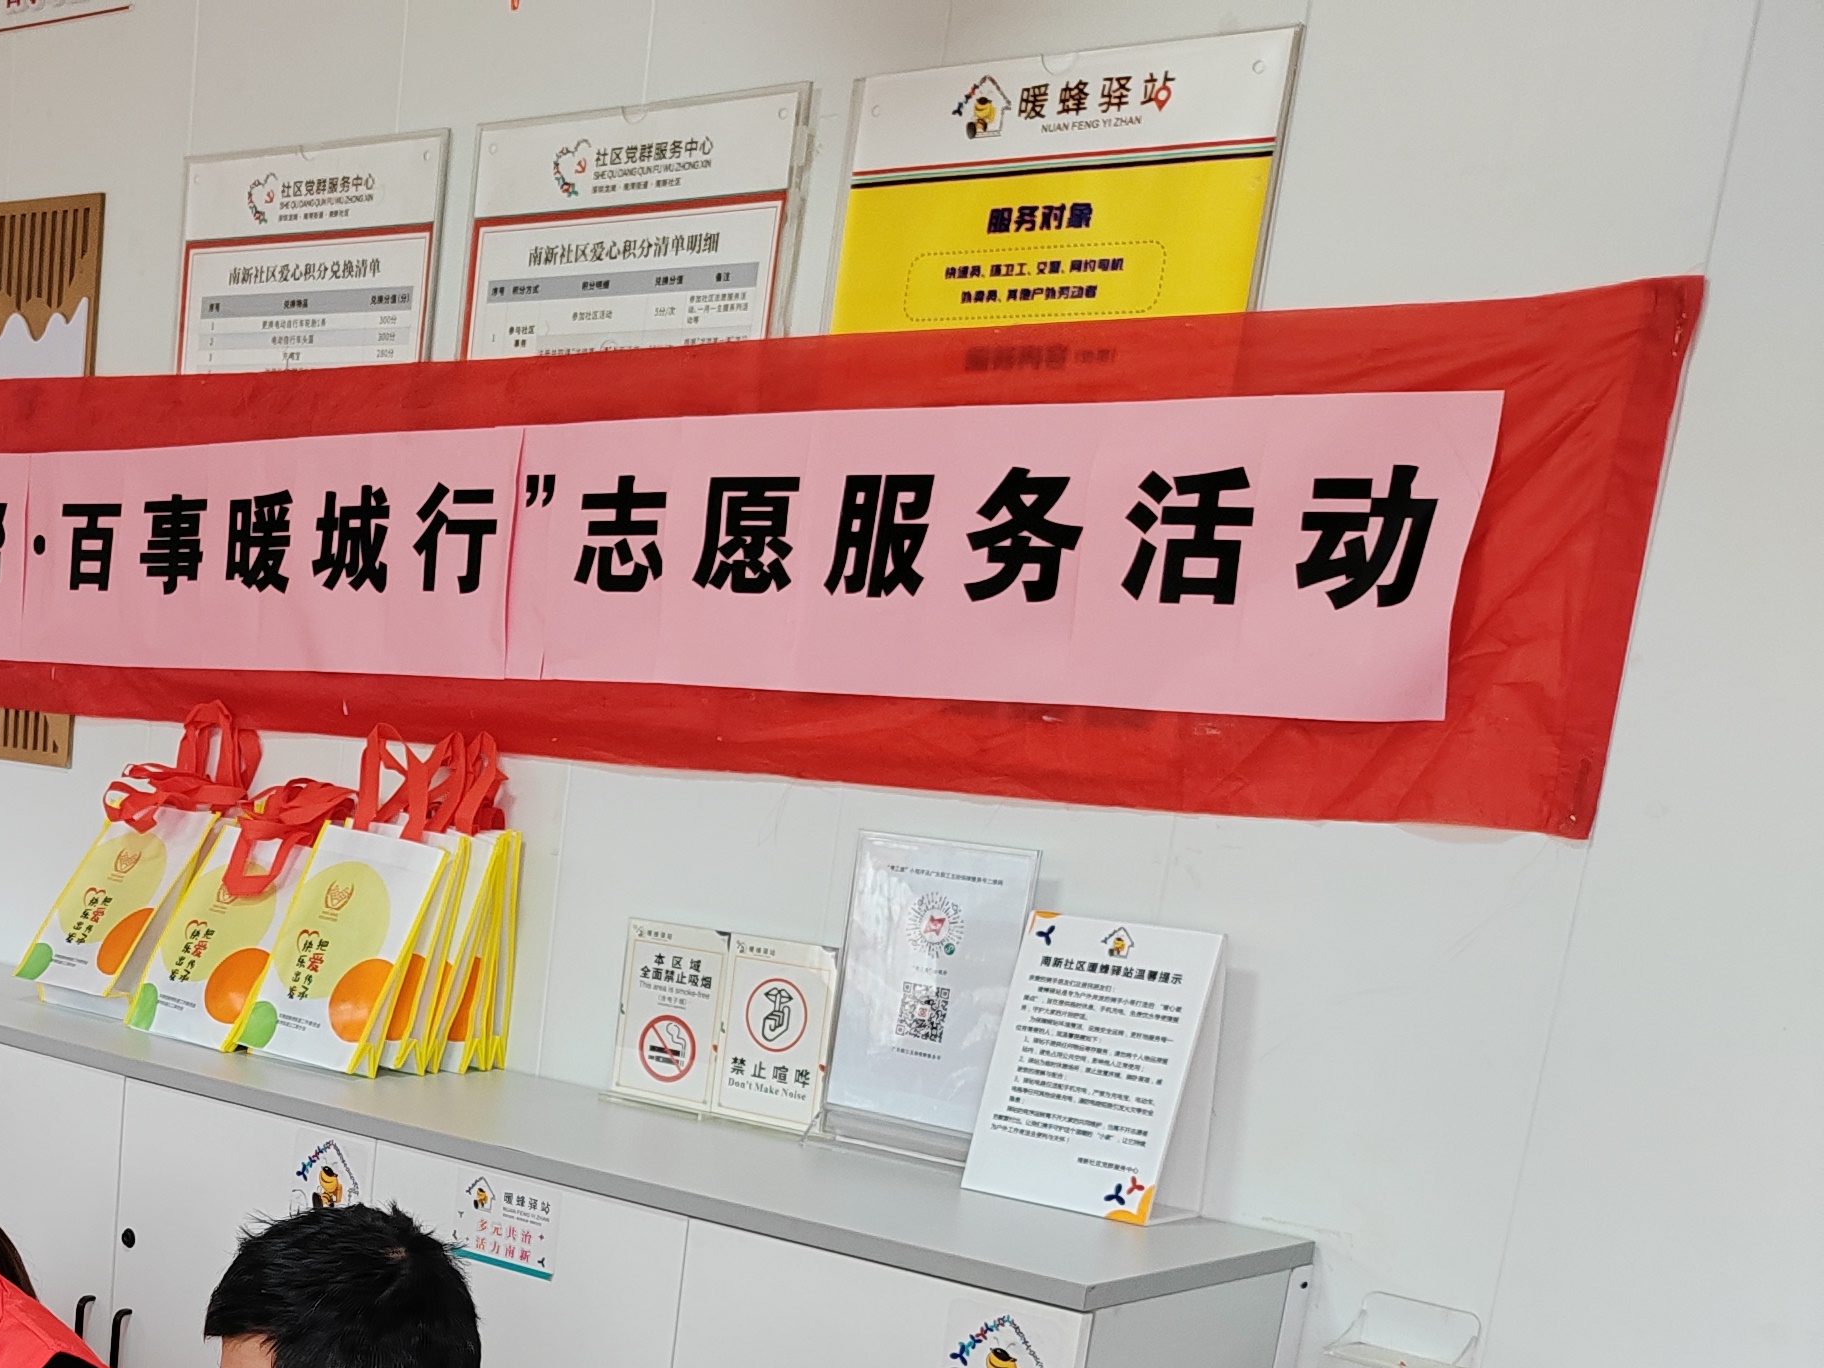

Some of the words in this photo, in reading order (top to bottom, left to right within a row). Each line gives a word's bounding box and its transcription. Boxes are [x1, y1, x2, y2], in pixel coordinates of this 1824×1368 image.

[1017, 71, 1175, 120] 暖蜂驿站
[1041, 121, 1069, 133] NUAN
[1072, 119, 1100, 131] FENG
[1102, 117, 1113, 129] YI
[1114, 115, 1142, 128] ZHAN
[595, 136, 714, 167] 社区党群服务中心
[281, 173, 375, 199] 社区党群服务中心
[987, 202, 1093, 234] 服务对象
[528, 232, 720, 268] 南新社区爱心积分清单明细
[228, 257, 381, 286] 南新社区爱心积分兑换清单
[654, 952, 702, 973] 本区域
[1040, 955, 1183, 985] 南新社区暖蜂驿站温馨提示
[639, 980, 651, 989] This
[652, 983, 667, 991] area
[640, 965, 713, 990] 全面禁止吸烟
[730, 1056, 811, 1089] 禁止喧哗
[728, 1077, 753, 1092] Don't
[755, 1081, 780, 1096] Make
[781, 1085, 807, 1101] Noise
[503, 1191, 552, 1215] 暖蜂驿站
[477, 1219, 533, 1245] 多元共治
[475, 1237, 532, 1264] 活力南新
